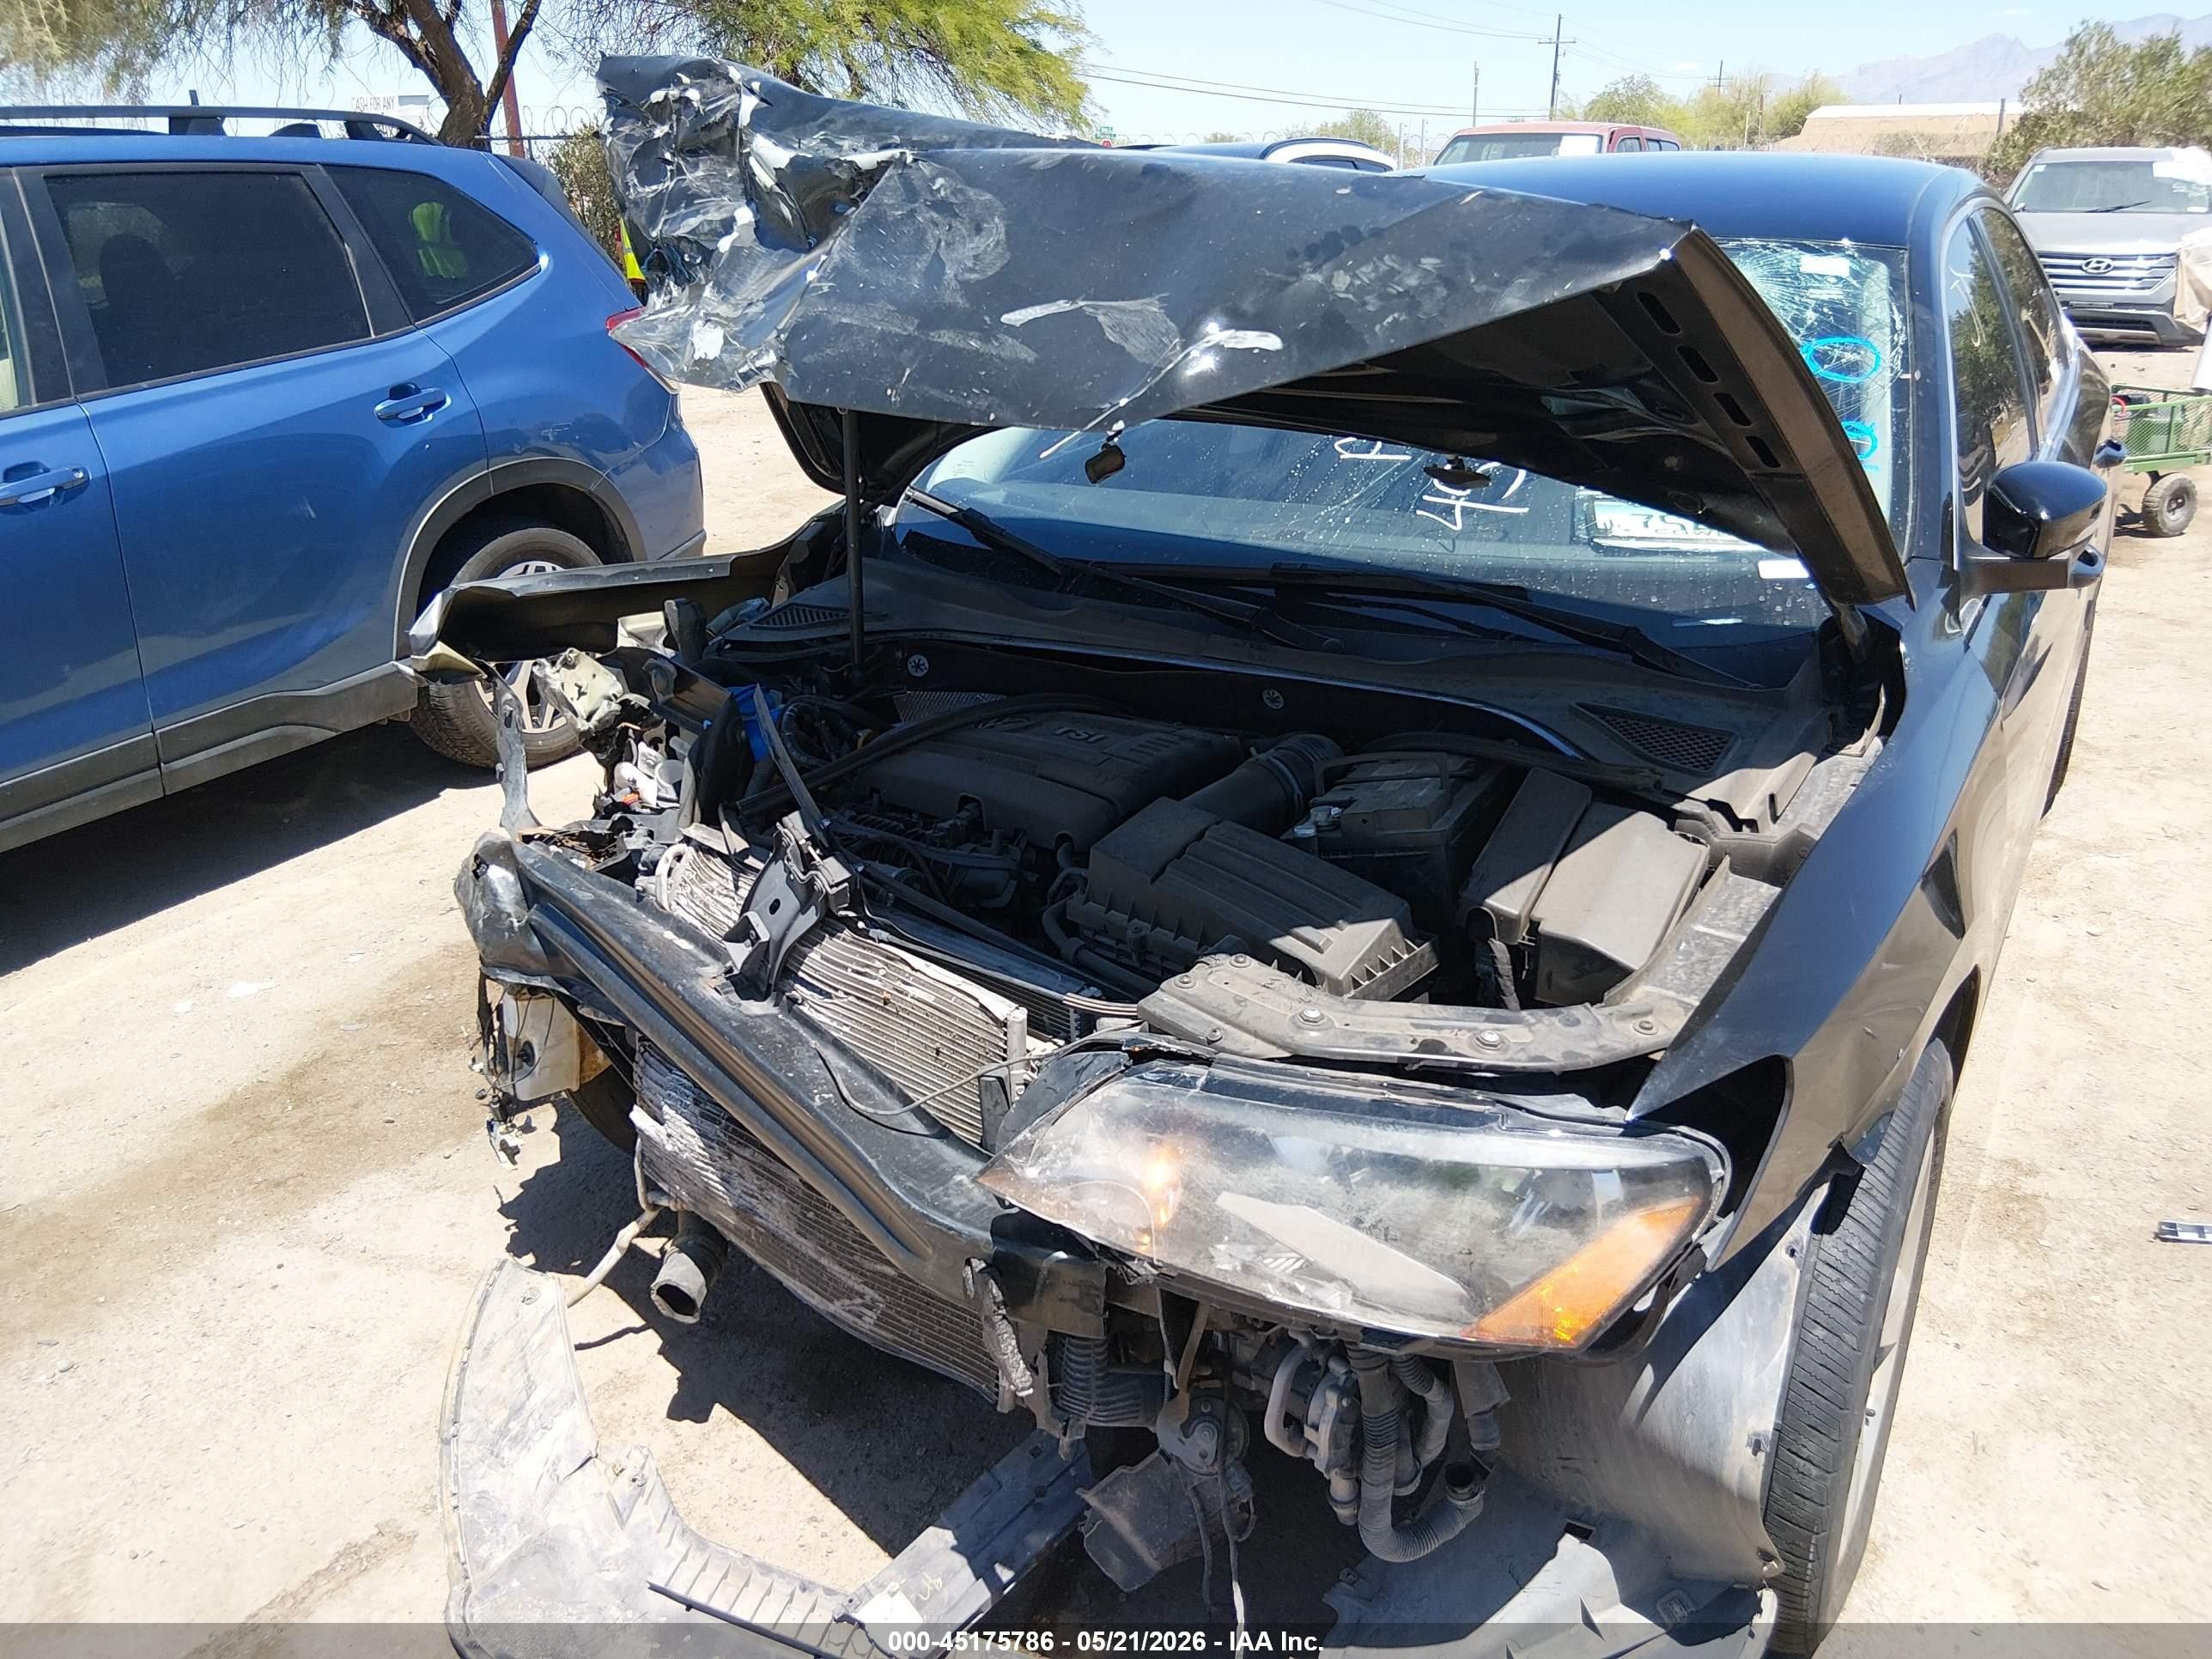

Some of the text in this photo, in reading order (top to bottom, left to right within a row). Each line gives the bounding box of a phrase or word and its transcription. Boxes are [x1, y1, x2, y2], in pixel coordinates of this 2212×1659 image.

[351, 95, 395, 111] CASH FOR ANY
[1052, 726, 1108, 744] TSI
